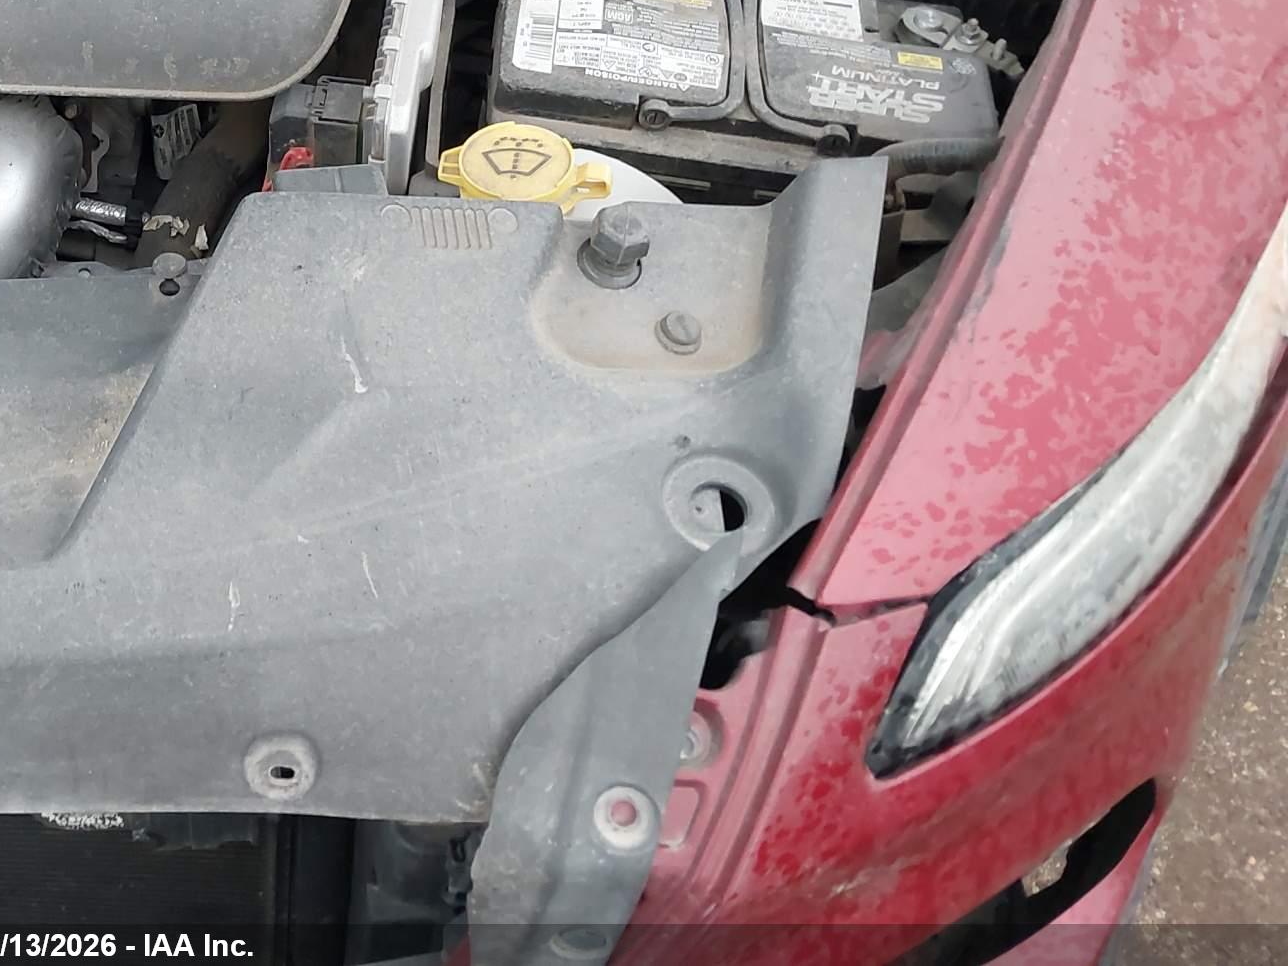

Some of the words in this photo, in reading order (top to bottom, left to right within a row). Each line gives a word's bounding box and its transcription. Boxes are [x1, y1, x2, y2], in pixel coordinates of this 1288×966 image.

[807, 76, 946, 112] START
[831, 65, 941, 91] PLATINUM
[809, 90, 930, 124] SUPER
